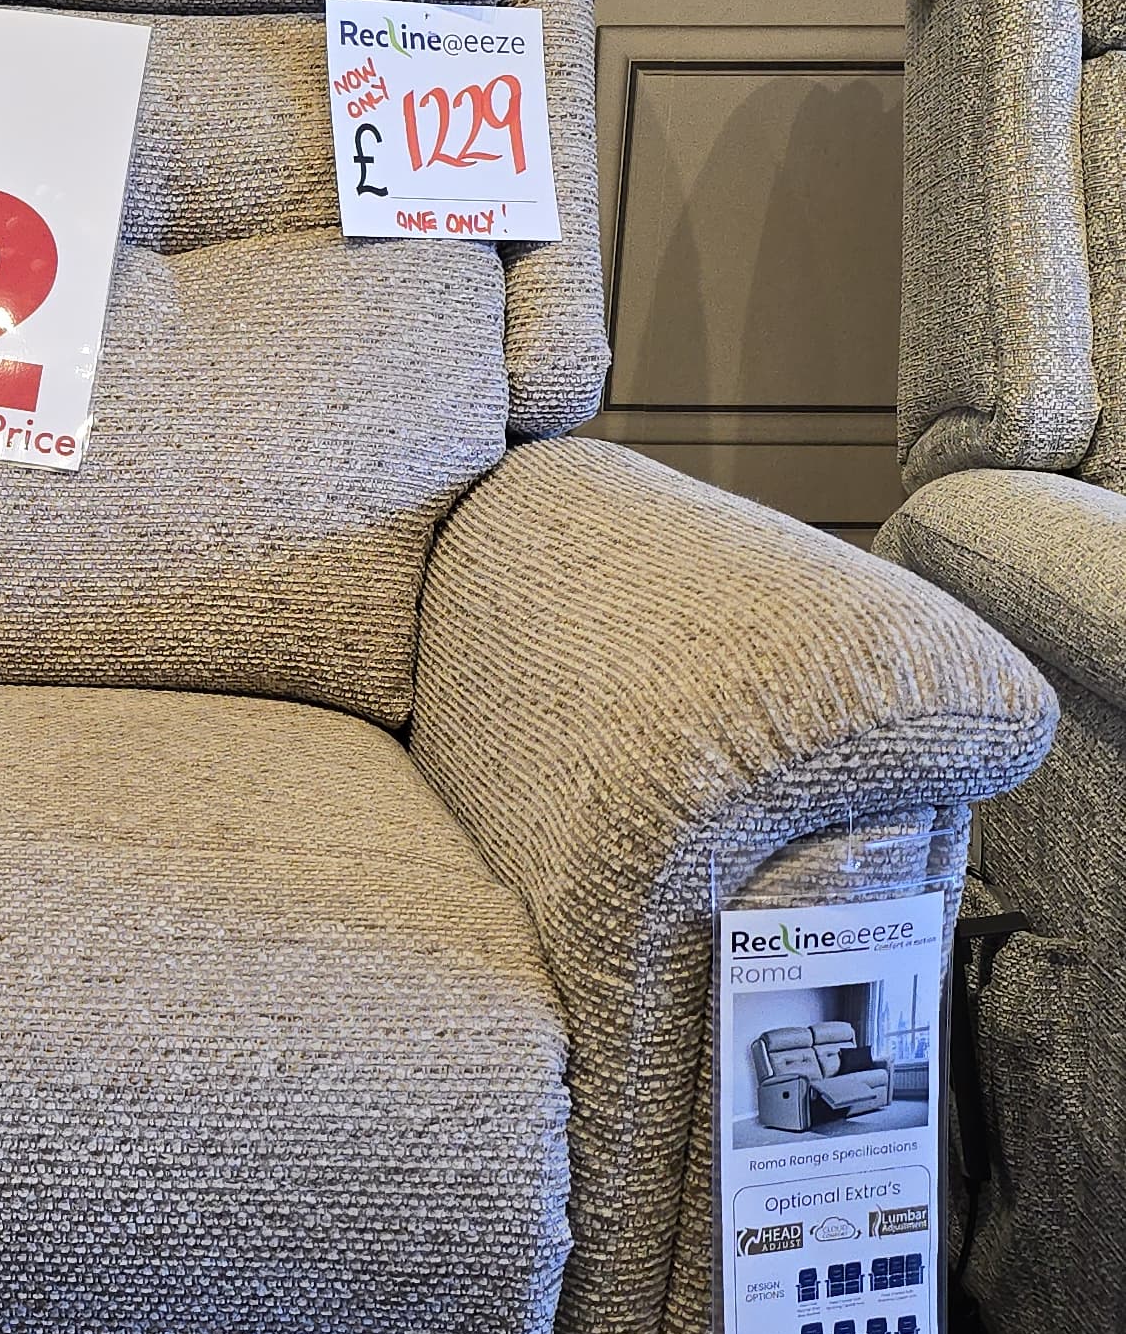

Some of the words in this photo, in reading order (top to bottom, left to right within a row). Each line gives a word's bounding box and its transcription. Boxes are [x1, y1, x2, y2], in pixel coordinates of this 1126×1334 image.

[340, 17, 526, 58] Recline@eeze
[334, 57, 377, 95] NOW
[347, 76, 390, 119] ONLY
[353, 123, 389, 197] £
[402, 74, 527, 174] 1229
[396, 210, 438, 234] ONE
[731, 922, 914, 957] Recline@eeze
[730, 965, 802, 985] Roma
[749, 1157, 786, 1171] Roma
[789, 1152, 829, 1167] Range
[832, 1140, 918, 1164] Specifications
[765, 1187, 840, 1216] Optional
[845, 1181, 901, 1201] Extra's
[882, 1209, 927, 1225] Lumbar
[761, 1238, 801, 1252] ADJUST
[762, 1225, 801, 1243] HEAD
[745, 1289, 785, 1303] OPTIONS
[747, 1281, 780, 1293] DESIGN
